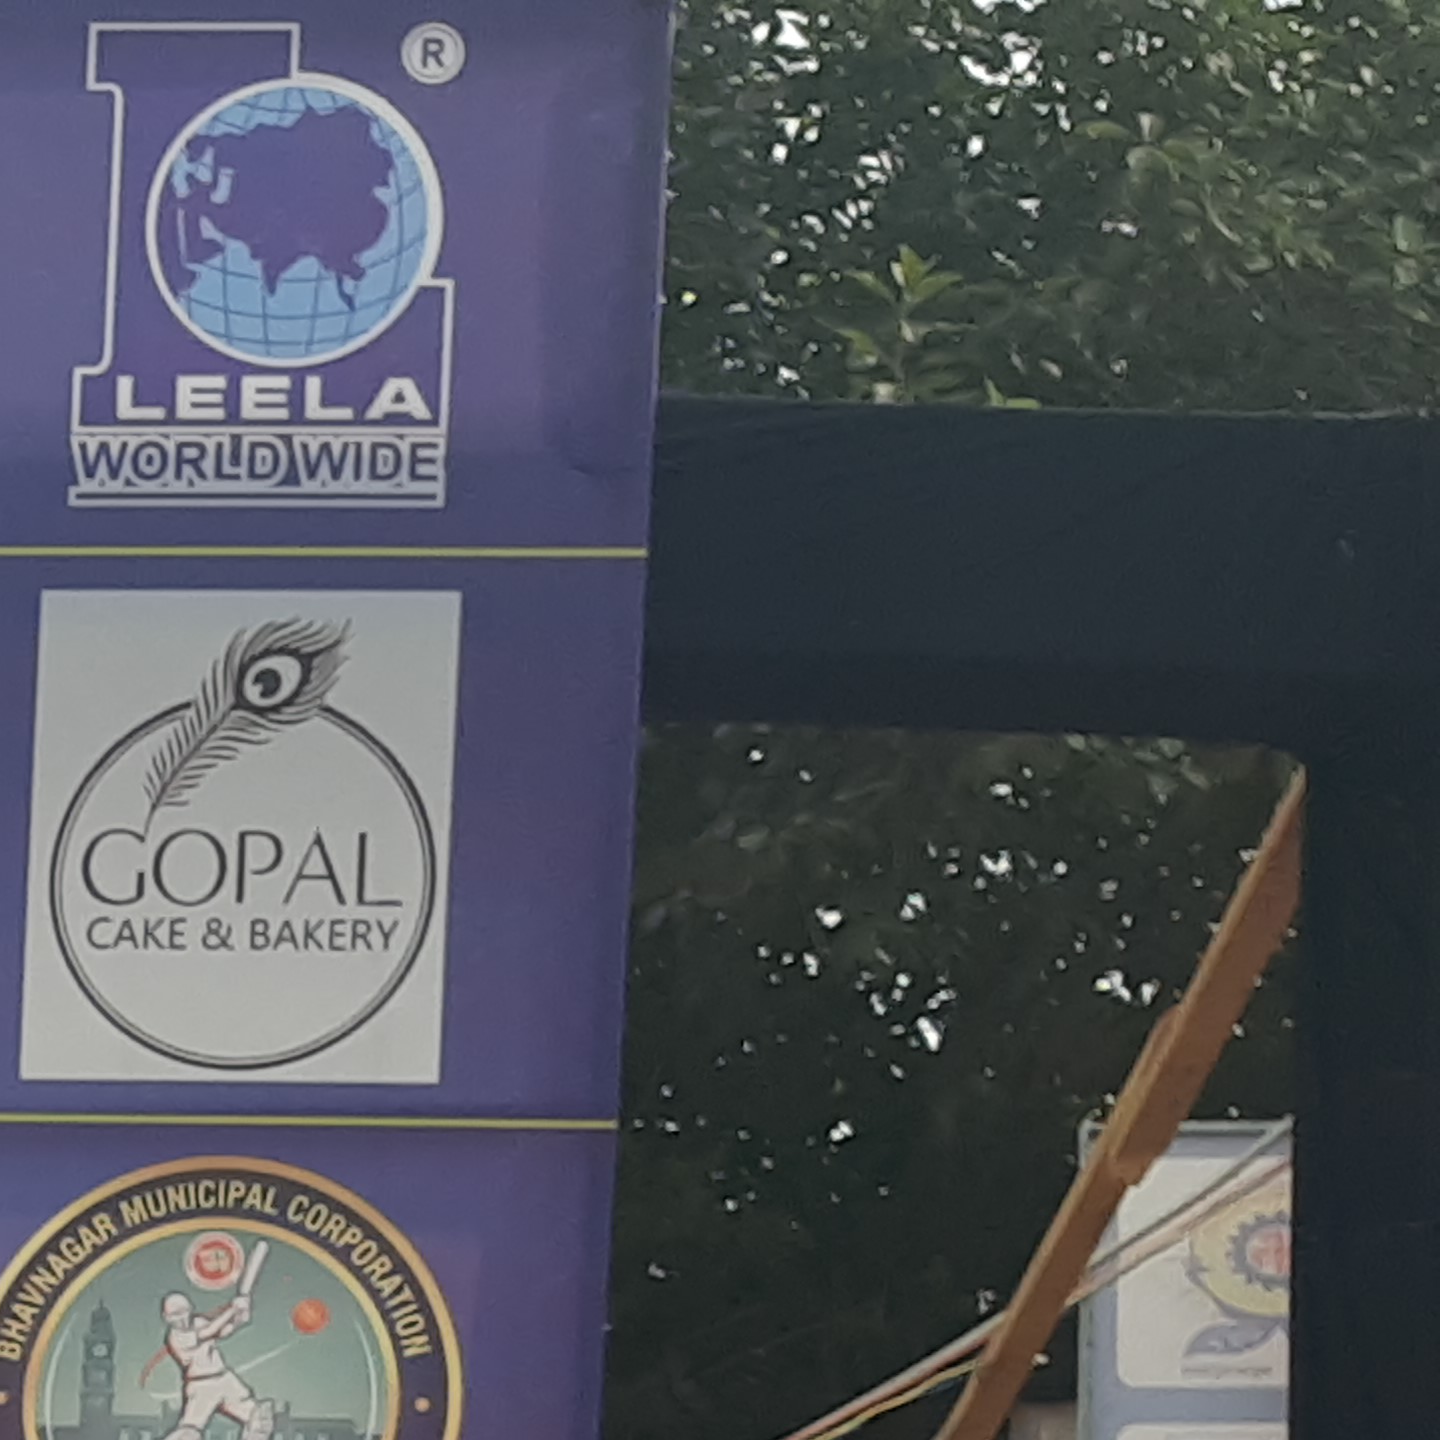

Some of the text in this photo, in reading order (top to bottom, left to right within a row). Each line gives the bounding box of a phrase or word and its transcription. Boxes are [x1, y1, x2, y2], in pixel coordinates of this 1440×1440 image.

[115, 374, 434, 421] LEELA
[79, 440, 440, 485] WORLD WIDE
[81, 827, 403, 907] GOPAL
[86, 916, 400, 952] CAKE & BAKERY
[120, 1178, 280, 1229] MUNICIPAL
[286, 1193, 433, 1360] CORPORATION
